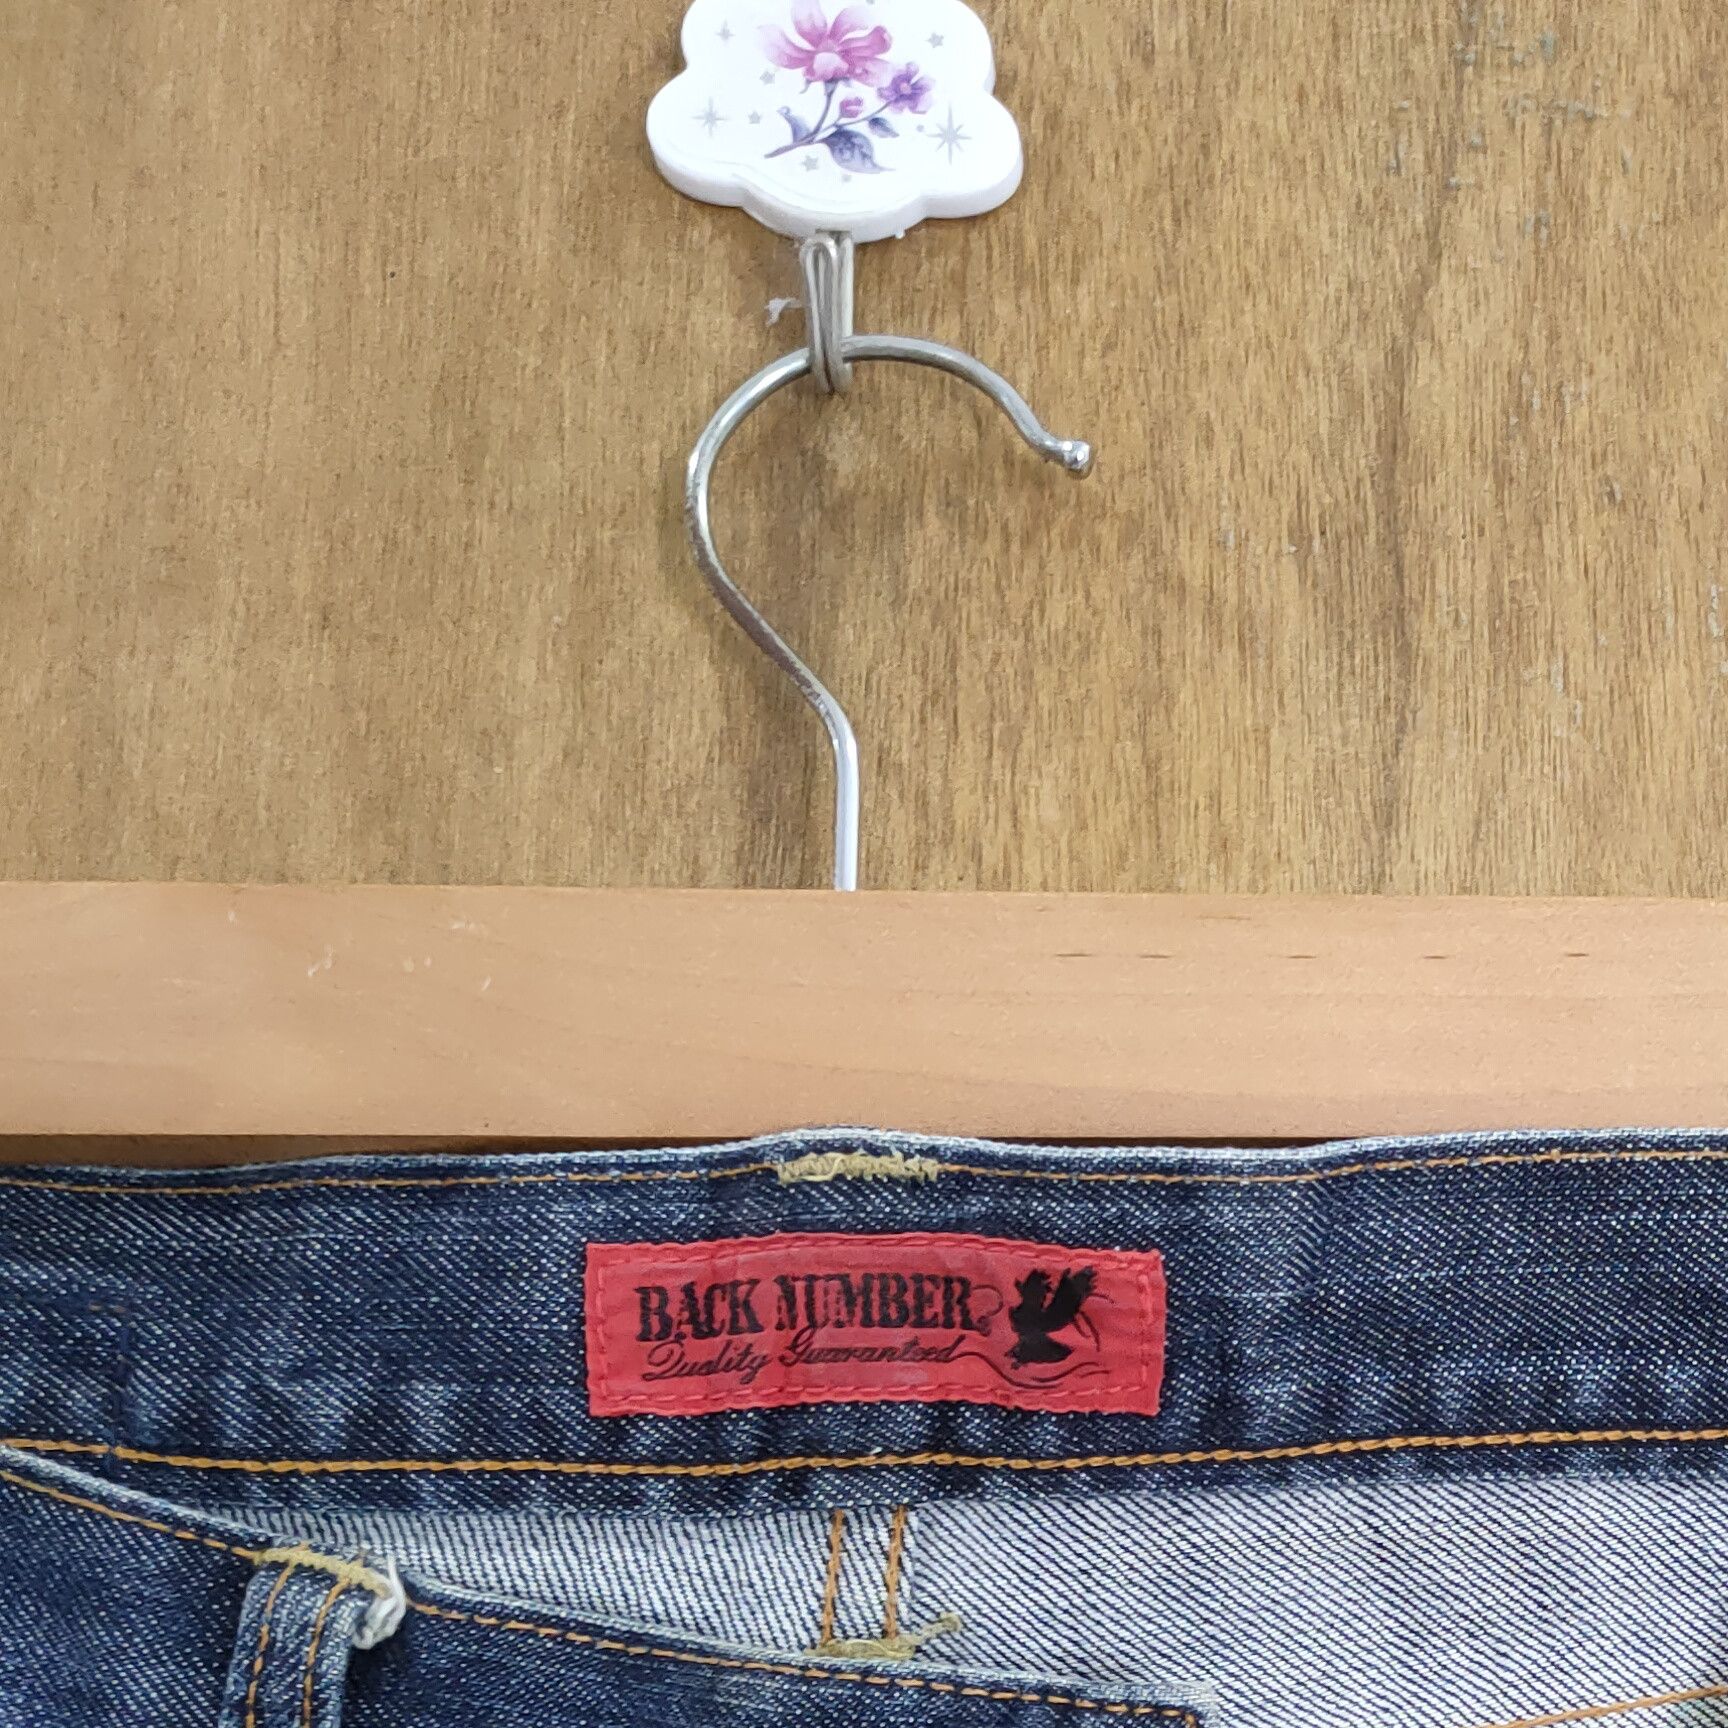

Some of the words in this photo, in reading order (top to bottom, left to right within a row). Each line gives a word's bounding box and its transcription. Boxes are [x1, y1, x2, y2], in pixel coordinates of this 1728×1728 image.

[634, 1280, 765, 1342] BACK
[773, 1272, 988, 1336] NUMBER
[641, 1339, 772, 1385] Quality
[778, 1322, 966, 1367] Guaranteed
